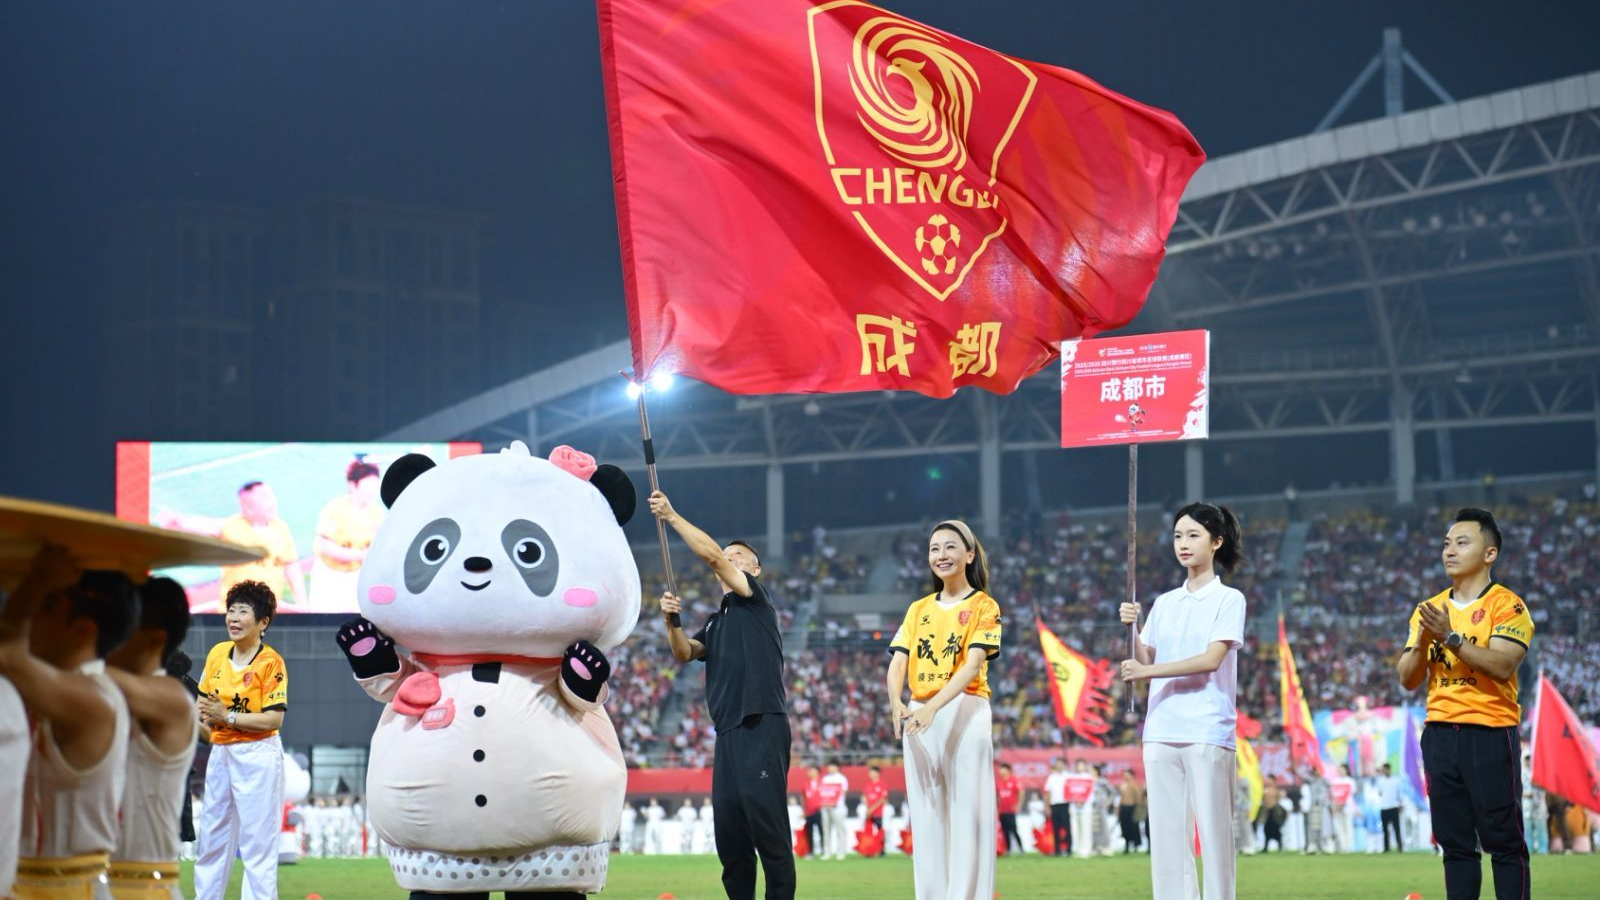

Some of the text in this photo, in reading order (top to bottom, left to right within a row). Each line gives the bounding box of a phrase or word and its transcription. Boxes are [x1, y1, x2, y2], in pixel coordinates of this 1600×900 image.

[856, 313, 1002, 380] 成都
[1100, 375, 1166, 402] 成都市
